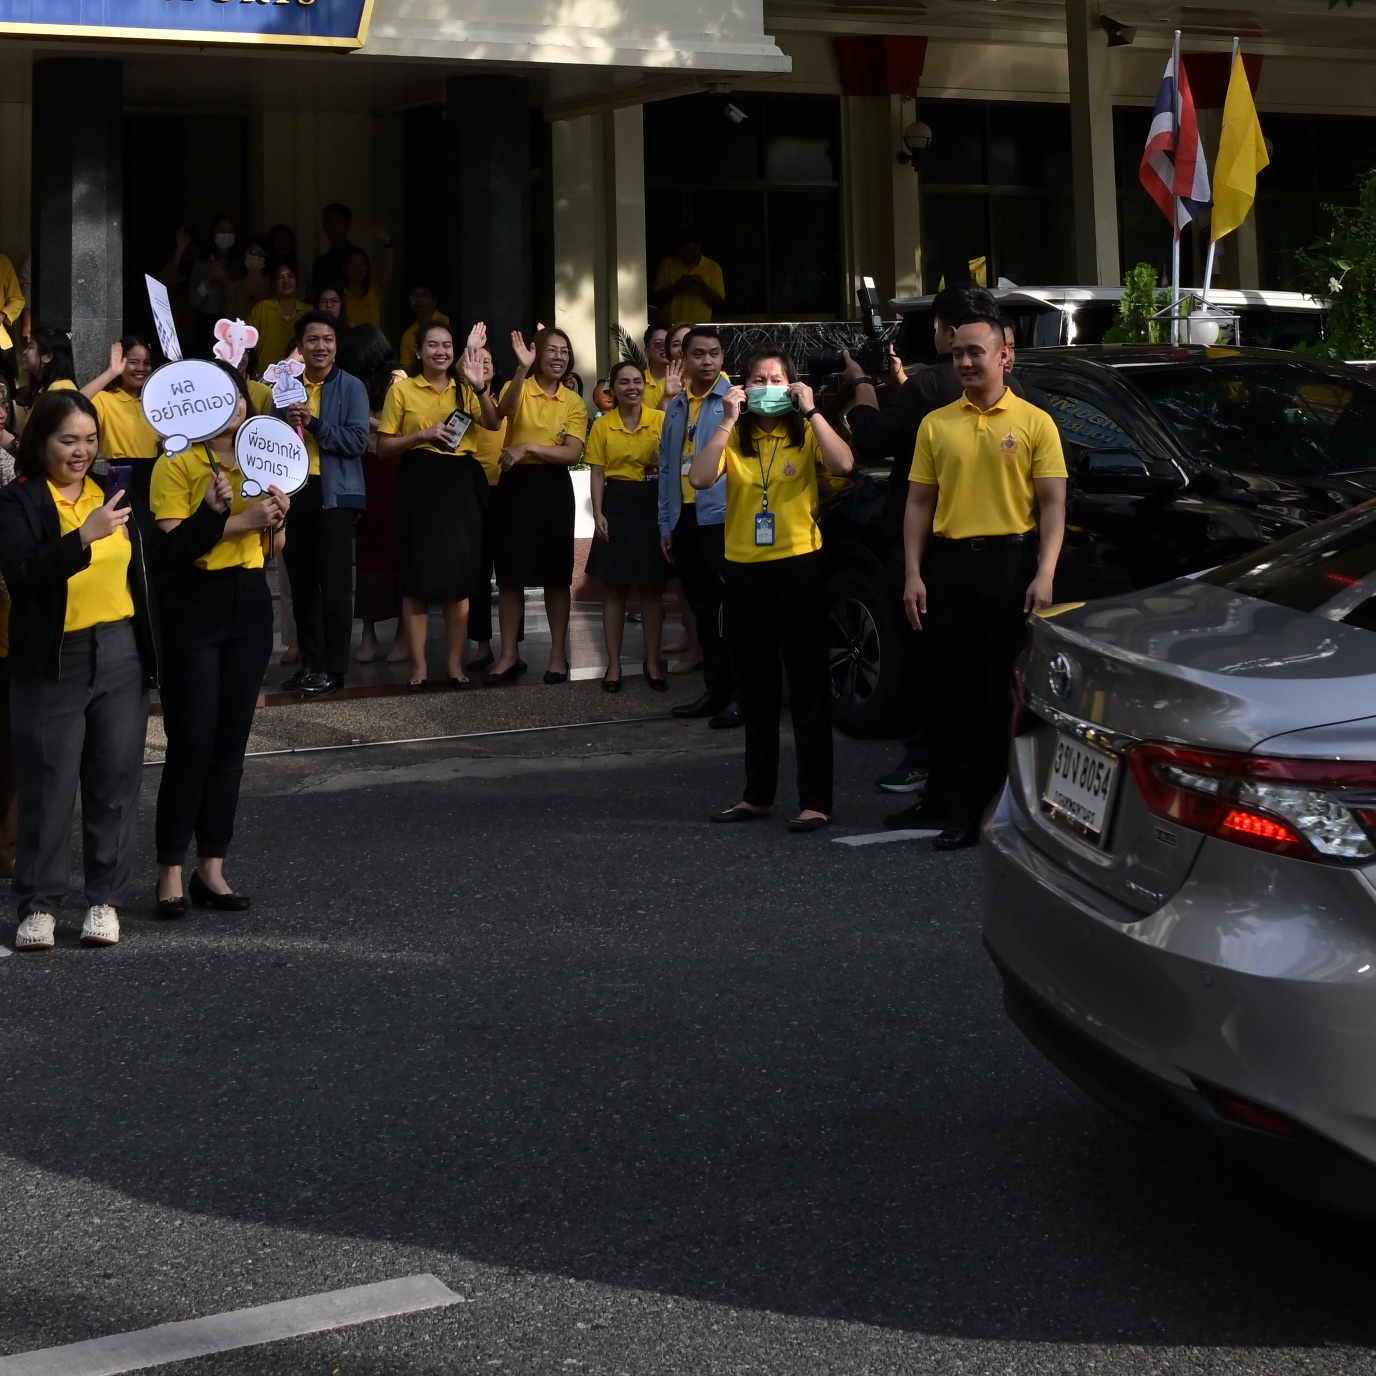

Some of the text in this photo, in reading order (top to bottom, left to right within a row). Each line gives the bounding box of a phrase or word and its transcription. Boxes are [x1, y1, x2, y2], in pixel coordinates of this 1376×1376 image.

[150, 392, 235, 423] อย่าคิดเอง
[247, 427, 302, 462] พี่อยากให้
[1079, 755, 1112, 801] 8054
